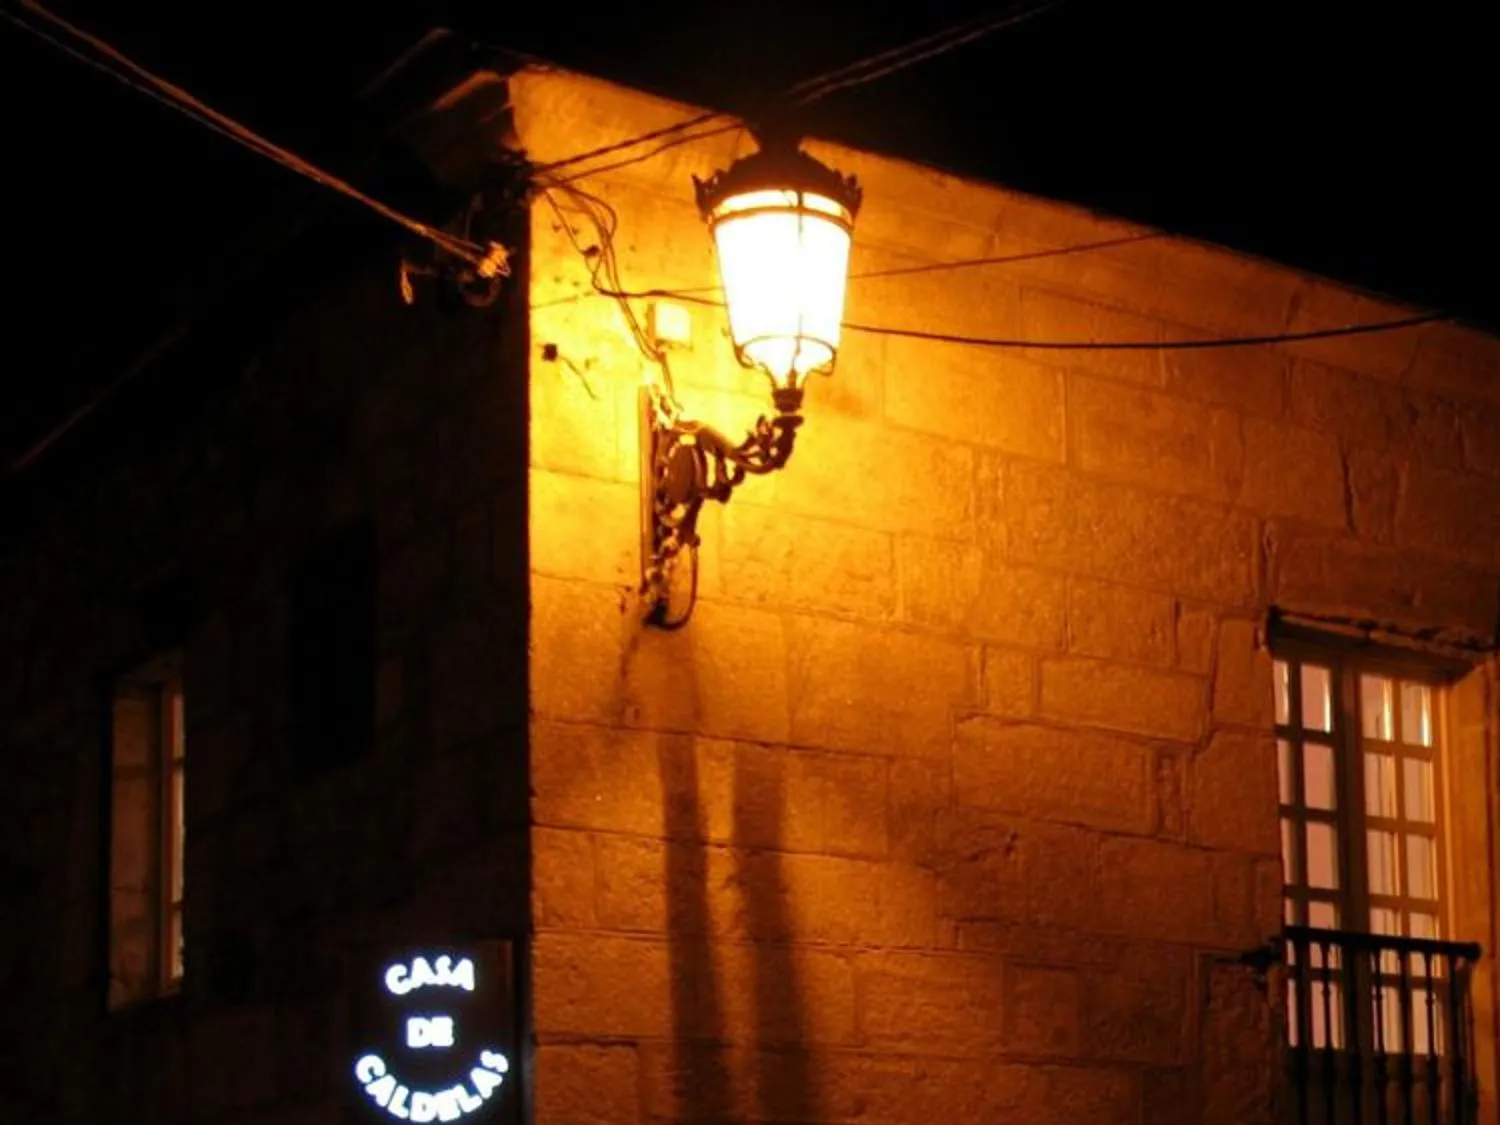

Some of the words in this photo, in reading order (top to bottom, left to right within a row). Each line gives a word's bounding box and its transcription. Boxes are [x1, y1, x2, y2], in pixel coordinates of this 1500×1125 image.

[385, 955, 475, 995] CASA
[407, 1016, 454, 1048] DE
[355, 1050, 509, 1123] CALDELAS
